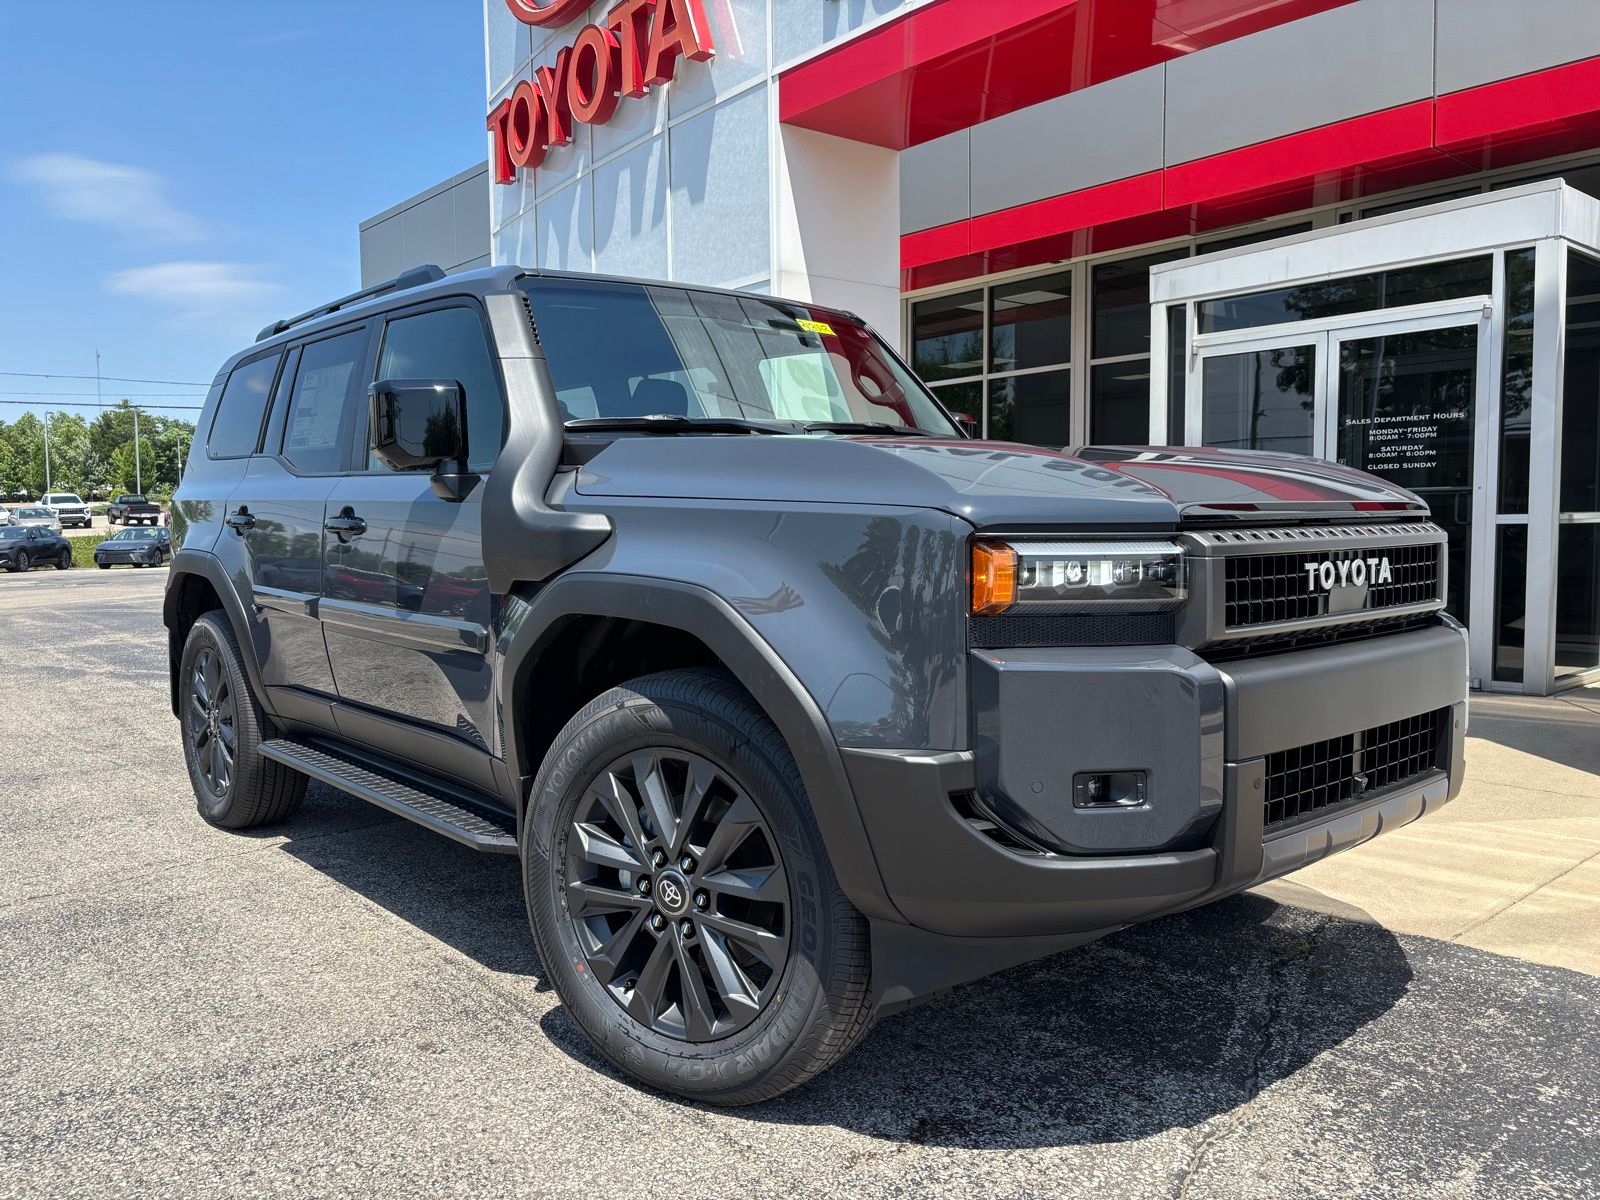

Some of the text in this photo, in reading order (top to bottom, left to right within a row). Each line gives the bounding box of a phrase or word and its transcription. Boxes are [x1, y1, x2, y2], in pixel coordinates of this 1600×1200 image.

[487, 0, 715, 185] TOYOTA
[1345, 411, 1465, 426] SALES DEPARTMENT HOURS
[1368, 425, 1438, 435] MONDAY-FRIDAY
[1380, 444, 1424, 452] SATURDAY
[1402, 461, 1437, 469] SUNDAY
[1304, 556, 1392, 591] TOYOTA
[545, 714, 627, 797] YOKOHAMA
